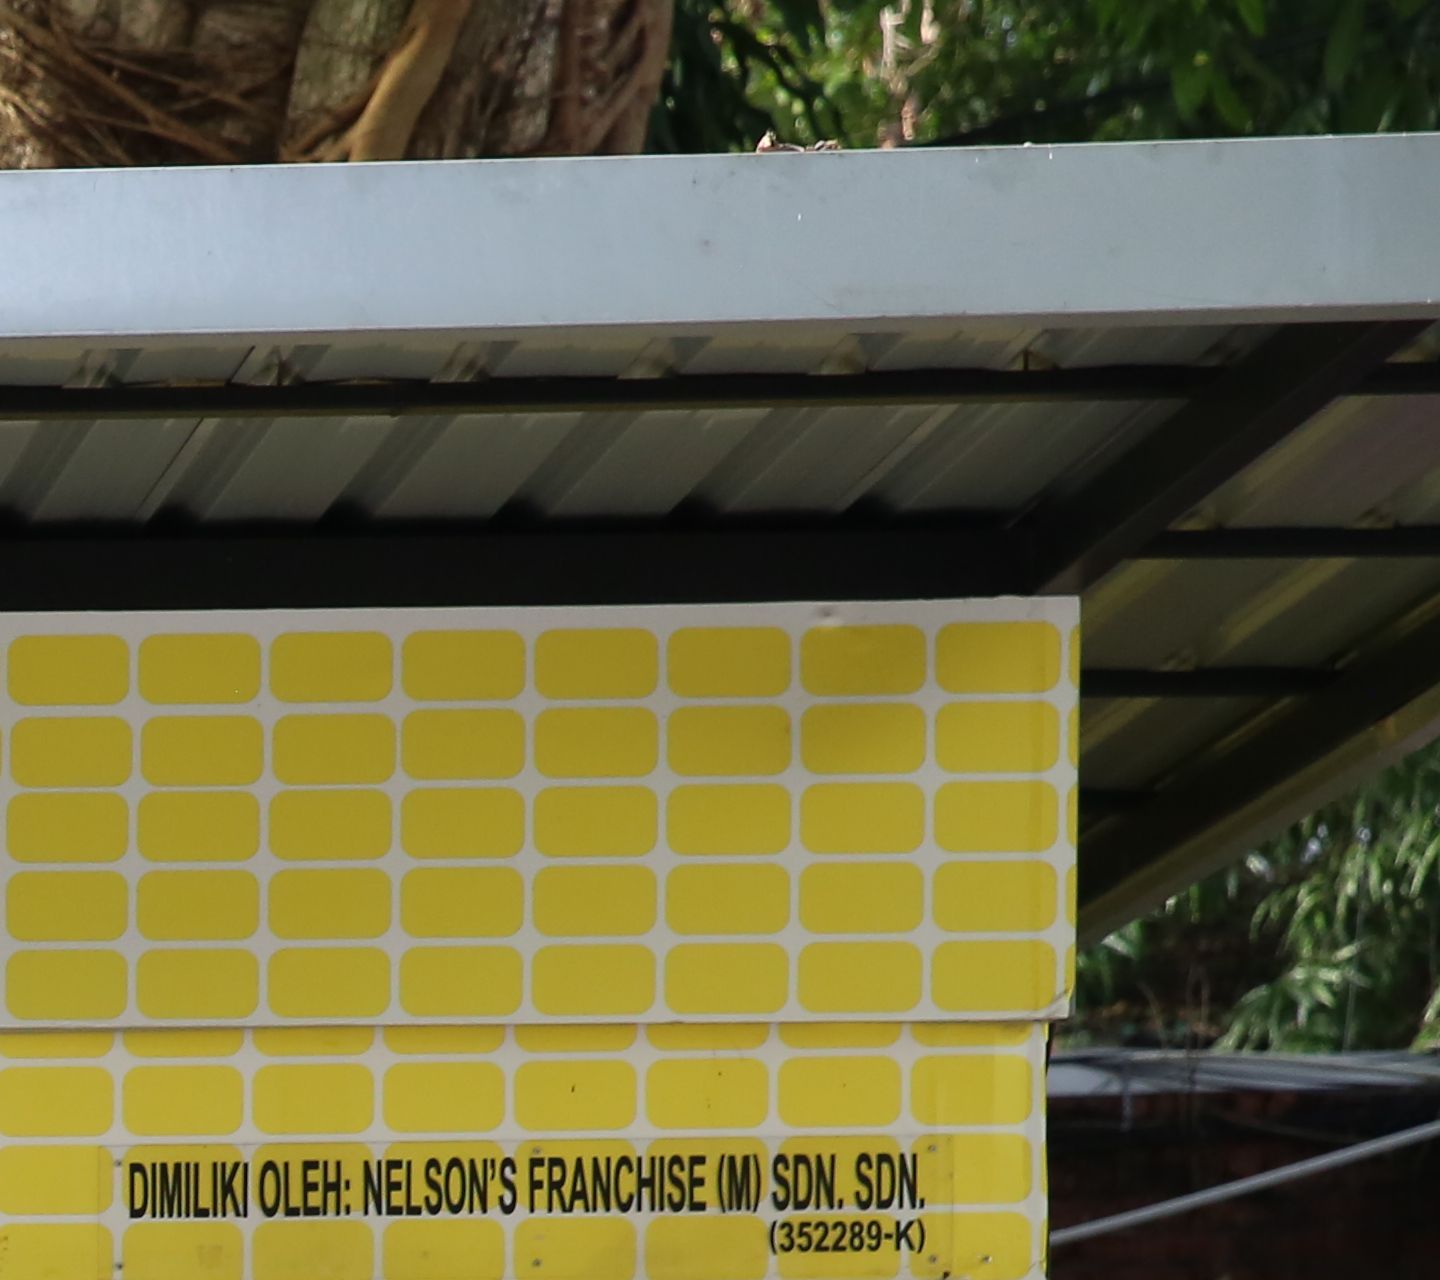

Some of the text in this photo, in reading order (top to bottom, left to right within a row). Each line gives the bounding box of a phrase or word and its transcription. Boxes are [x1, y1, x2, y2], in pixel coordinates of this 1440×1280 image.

[128, 1151, 924, 1218] DIMILIKI OLEH: NELSON'S FRANCHISE (M) SDN. SDN.
[769, 1221, 925, 1255] (352289-K)
